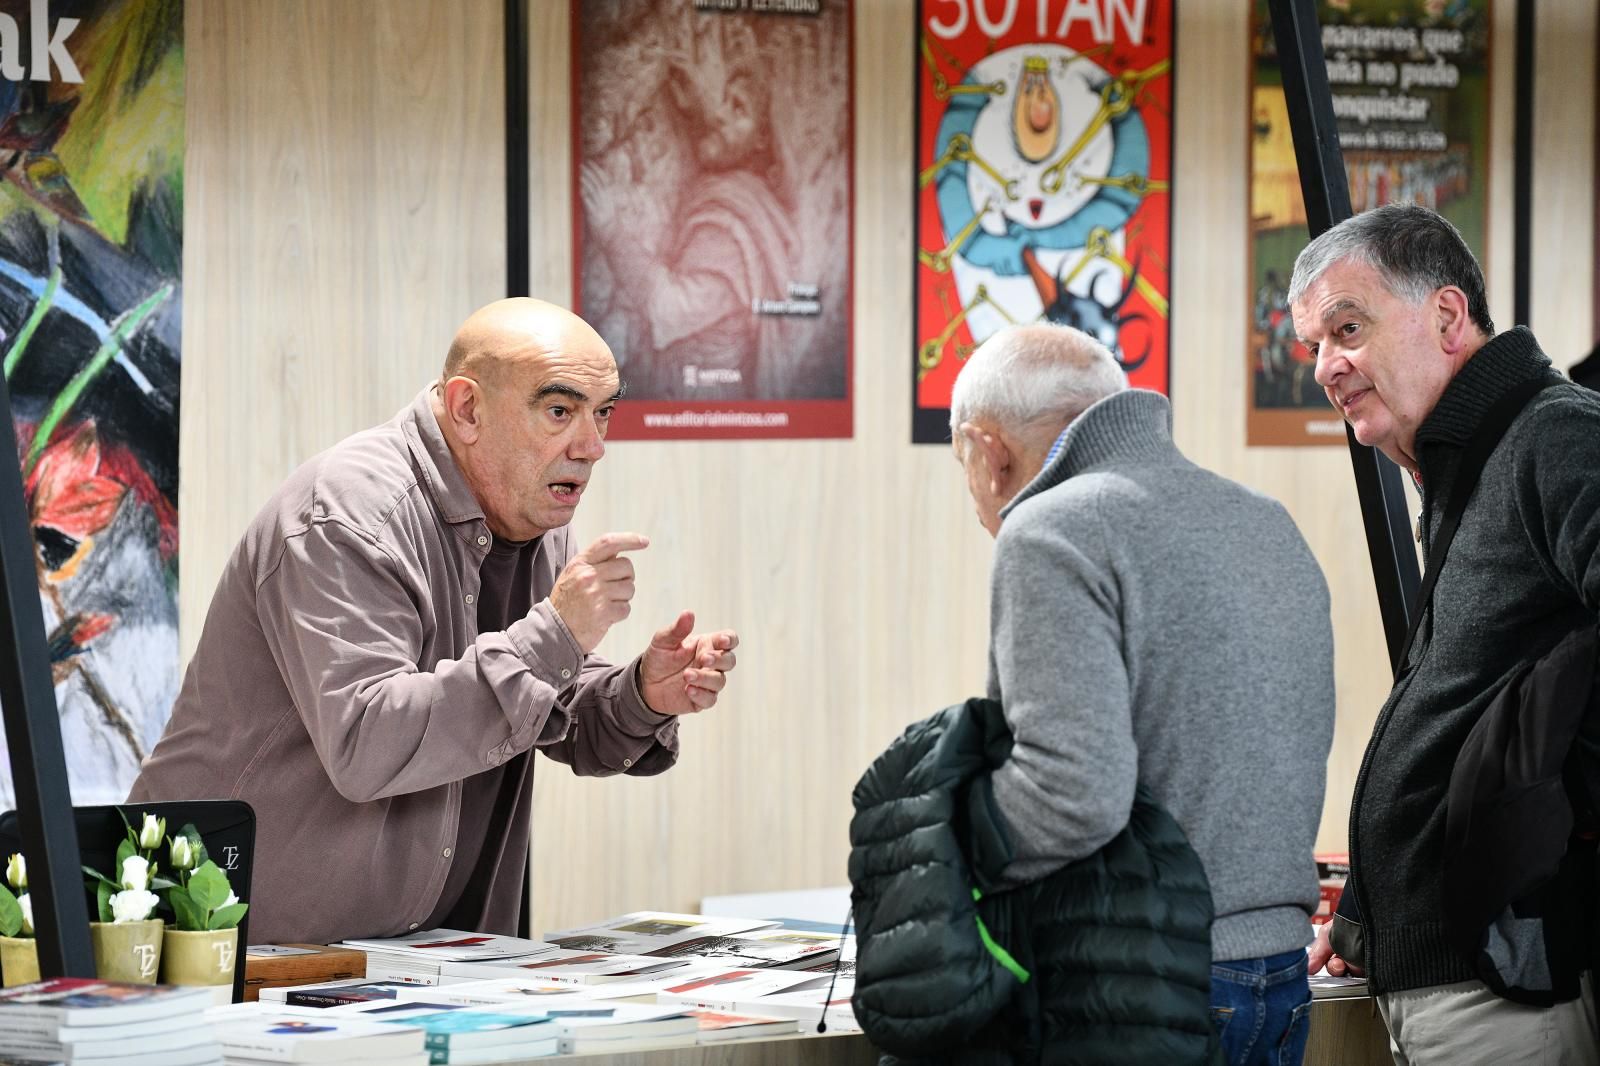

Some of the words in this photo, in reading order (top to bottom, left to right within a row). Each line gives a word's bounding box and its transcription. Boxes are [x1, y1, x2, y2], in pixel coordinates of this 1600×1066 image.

[1421, 29, 1464, 57] que
[1366, 62, 1398, 85] no
[1401, 55, 1460, 90] pudo
